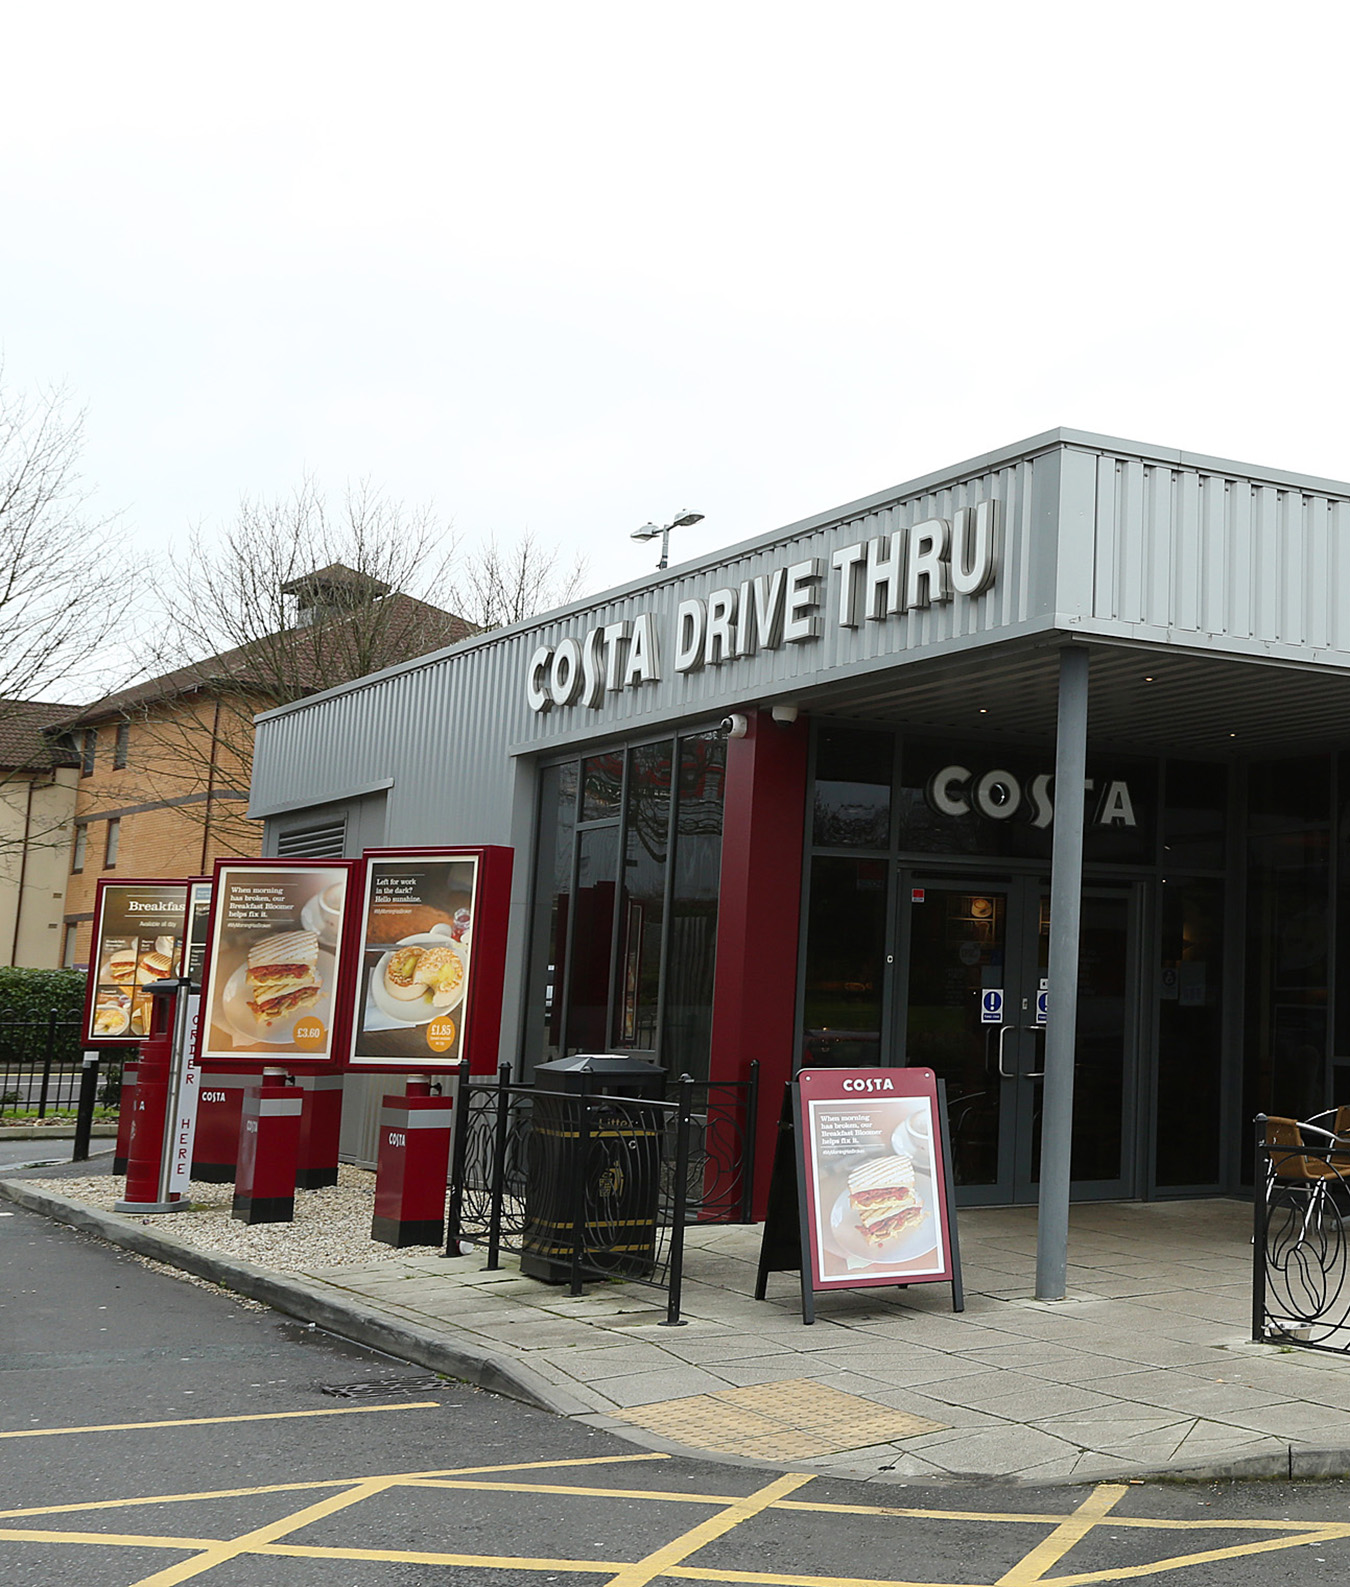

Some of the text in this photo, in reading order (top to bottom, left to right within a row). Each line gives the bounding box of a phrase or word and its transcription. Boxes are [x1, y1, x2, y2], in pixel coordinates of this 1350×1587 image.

[527, 499, 999, 713] COSTA DRIVE THRU
[931, 765, 1137, 829] COSA
[231, 886, 284, 895] When morning
[128, 901, 186, 912] Breakfas
[296, 1028, 320, 1039] £3.60
[431, 1024, 451, 1036] £1.85
[843, 1078, 894, 1092] COSTA
[202, 1092, 226, 1103] COSTA
[388, 1133, 406, 1147] COSTA
[177, 1119, 190, 1175] HERE
